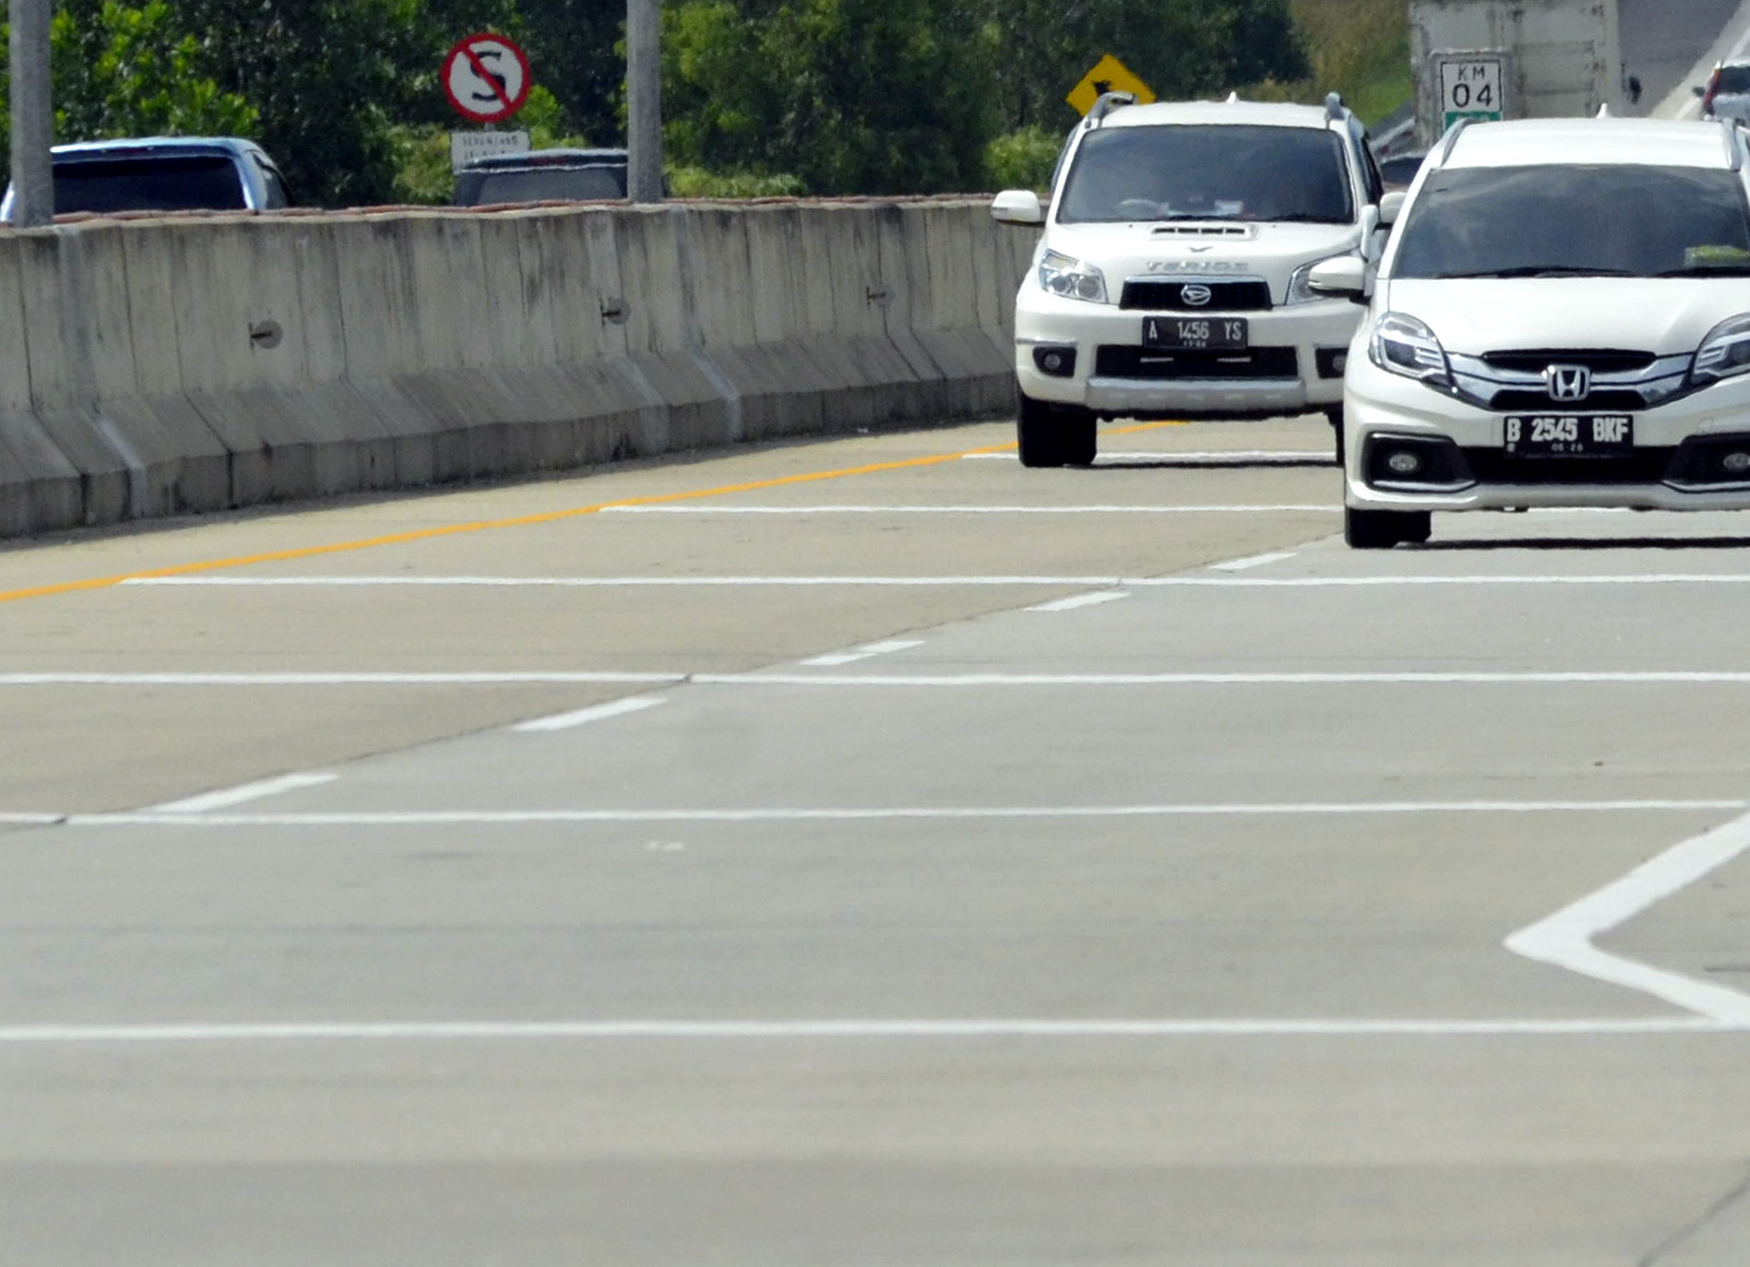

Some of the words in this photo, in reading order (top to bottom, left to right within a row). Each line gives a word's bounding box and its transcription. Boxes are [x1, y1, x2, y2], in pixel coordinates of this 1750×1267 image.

[1458, 65, 1485, 81] KM
[1452, 83, 1493, 108] 04
[1149, 320, 1158, 339] A
[1177, 321, 1209, 339] 1456
[1224, 321, 1242, 340] YS
[1507, 417, 1521, 442] B
[1531, 417, 1578, 442] 2545
[1592, 417, 1629, 442] BKF
